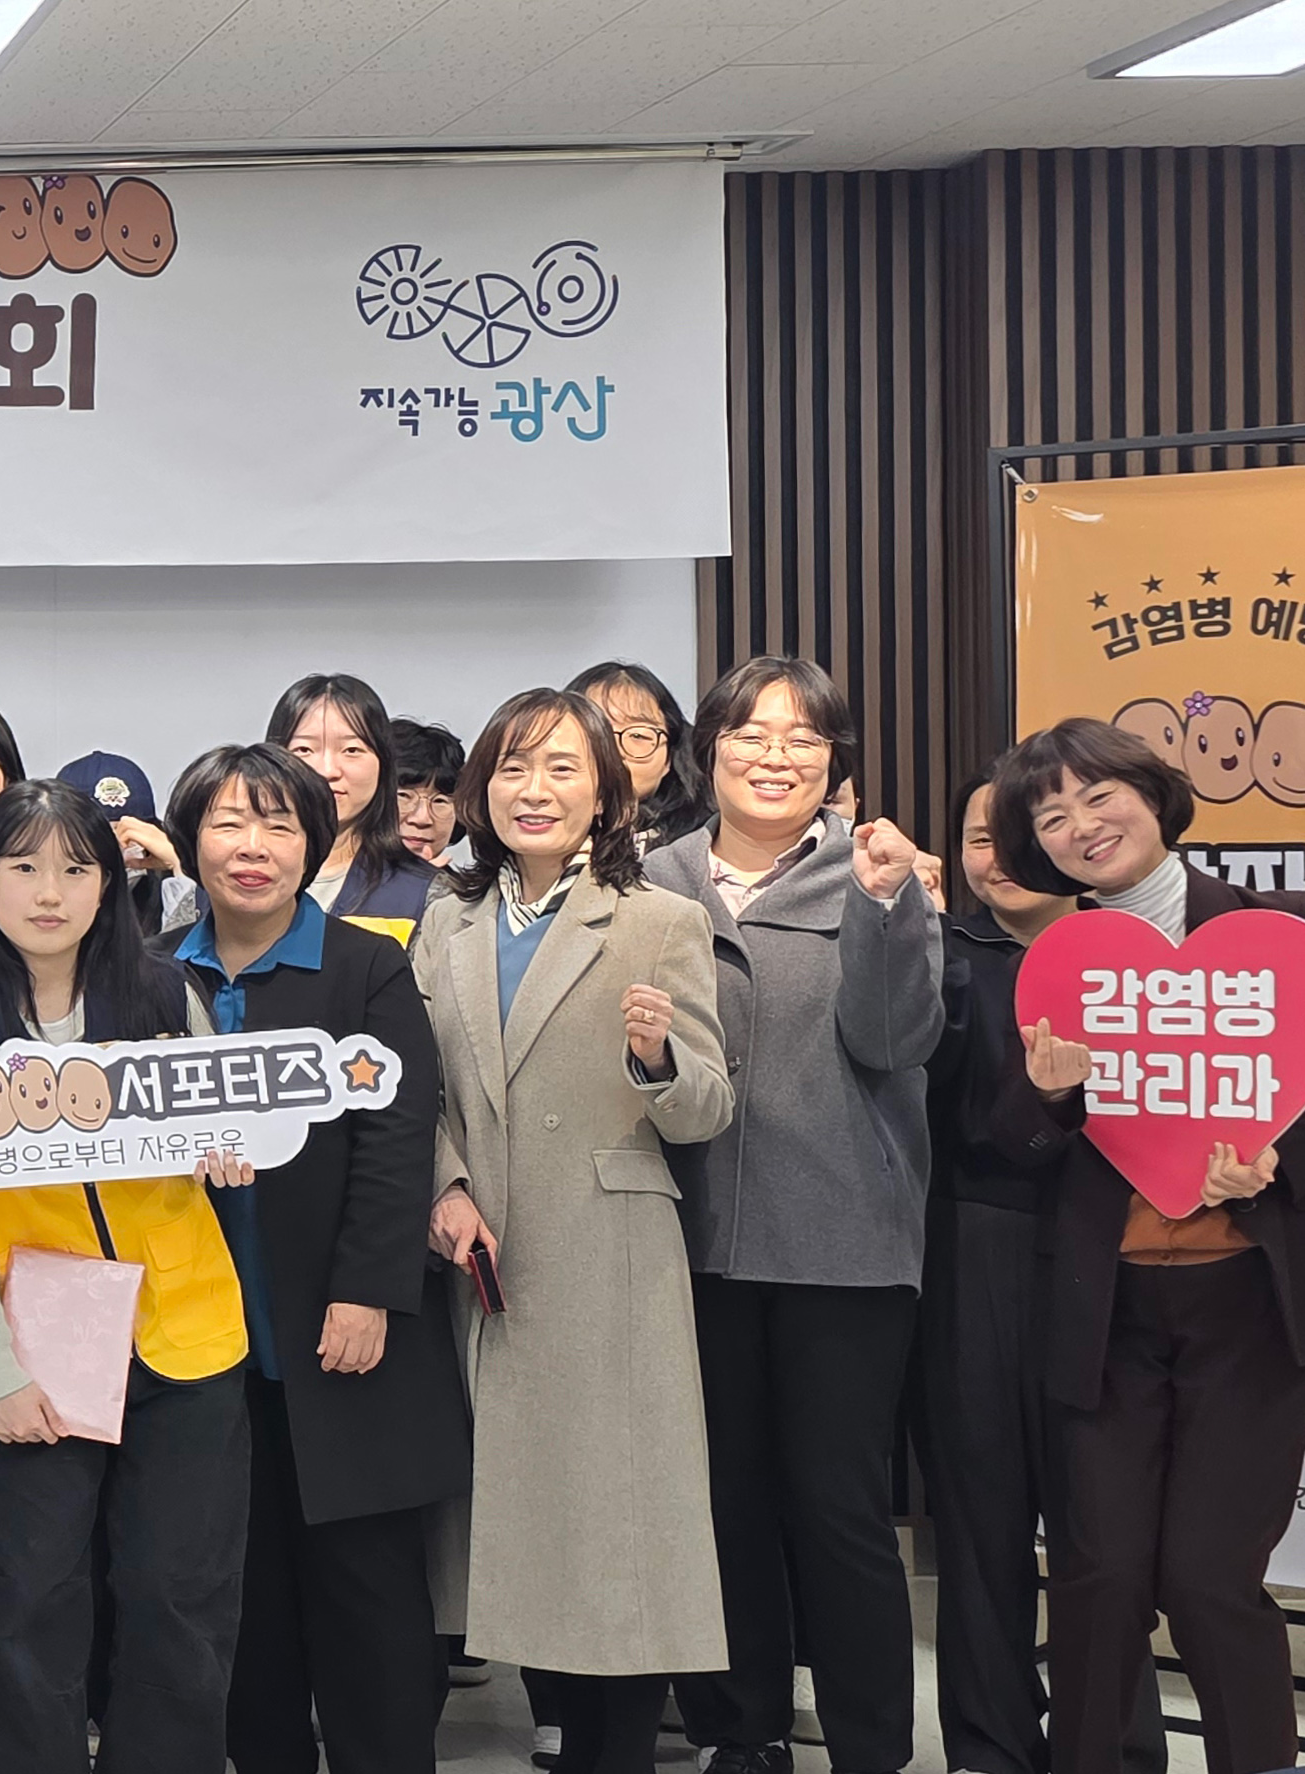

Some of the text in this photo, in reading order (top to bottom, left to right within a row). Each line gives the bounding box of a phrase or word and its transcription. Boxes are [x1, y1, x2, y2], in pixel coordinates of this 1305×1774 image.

[359, 375, 615, 442] 지속가능 광산
[1091, 597, 1305, 661] 감염병 예
[1080, 968, 1276, 1037] 감염병
[117, 1050, 327, 1113] 서포터즈
[1085, 1050, 1281, 1122] 관리과
